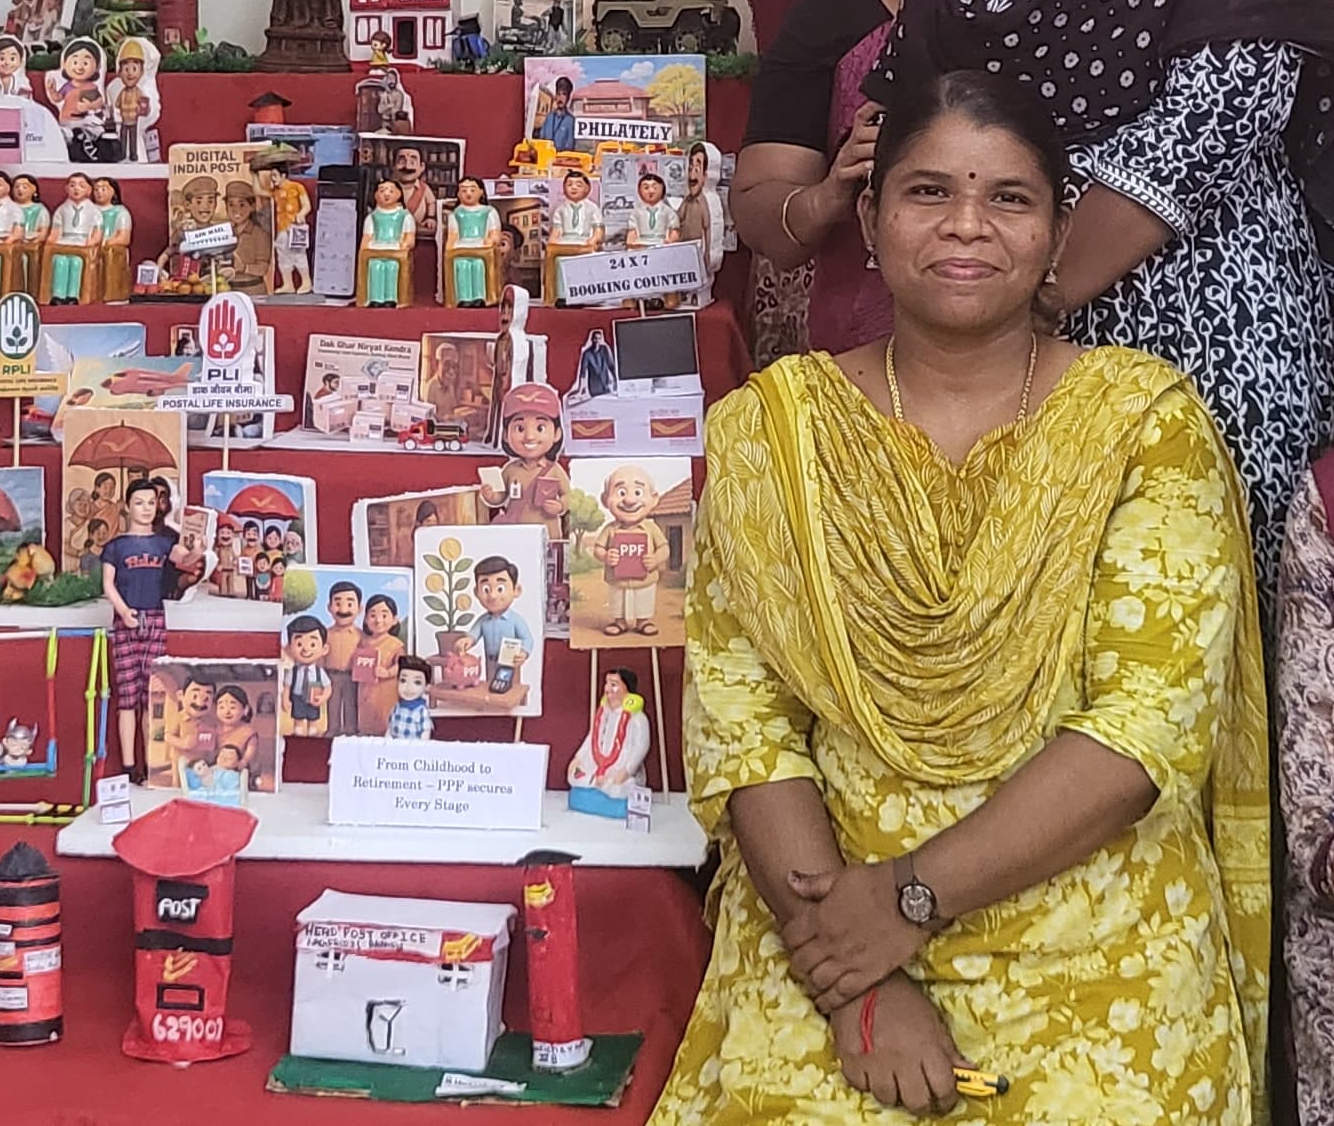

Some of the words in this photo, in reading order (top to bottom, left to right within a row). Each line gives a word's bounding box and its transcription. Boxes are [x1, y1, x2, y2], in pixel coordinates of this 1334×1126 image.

[577, 121, 673, 141] PHILATELY
[186, 150, 237, 163] DIGITAL
[173, 163, 207, 174] INDIA
[210, 162, 241, 173] POST
[609, 256, 627, 270] 24
[629, 255, 638, 268] X
[641, 254, 650, 266] 7
[569, 279, 631, 298] BOOKING
[633, 272, 699, 292] COUNTER
[2, 364, 31, 375] RPLI
[207, 368, 240, 381] PLI
[162, 399, 200, 408] POSTAL
[202, 399, 223, 408] LIFE
[225, 398, 283, 407] INSURANCE
[620, 543, 645, 557] PPF
[376, 758, 409, 771] From
[413, 759, 475, 774] Childhood
[479, 762, 492, 774] to
[353, 775, 422, 790] Retirement
[437, 779, 465, 793] PPF
[467, 783, 514, 794] secures
[395, 796, 432, 812] Every
[434, 798, 470, 814] Stage
[158, 897, 202, 919] POST
[305, 922, 338, 937] HEAD
[343, 926, 374, 942] POST
[380, 930, 427, 944] OFFICE
[153, 1013, 224, 1043] 629001
